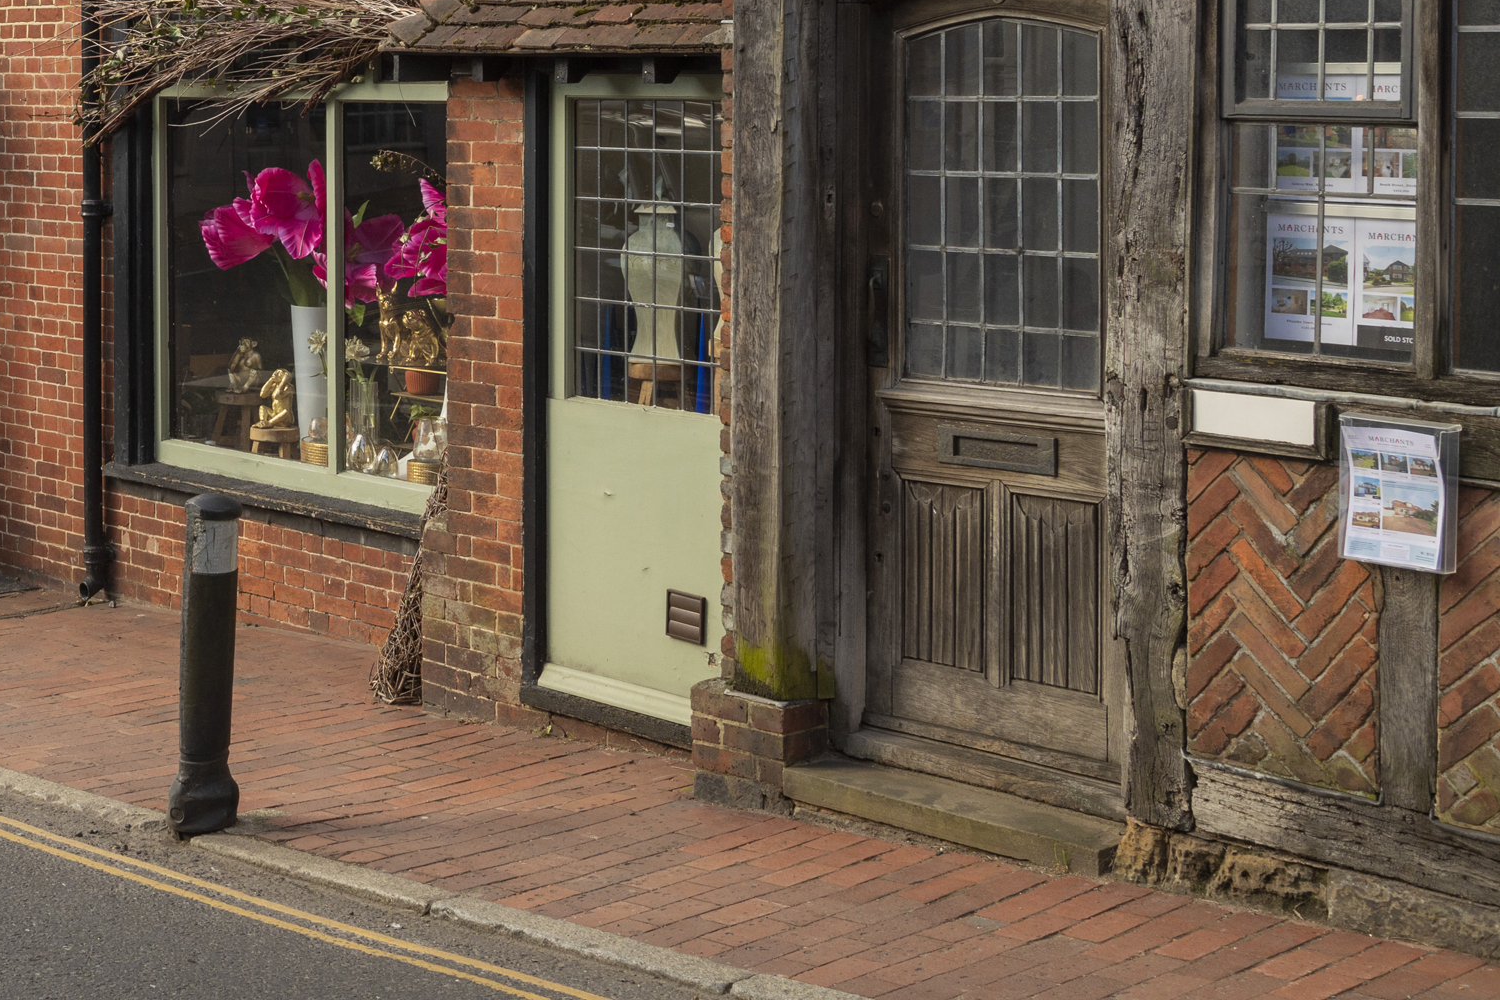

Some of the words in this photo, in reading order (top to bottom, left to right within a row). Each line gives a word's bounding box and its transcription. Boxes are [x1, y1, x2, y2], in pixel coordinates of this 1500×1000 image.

[1278, 82, 1347, 91] MARCHNTS
[1278, 223, 1344, 234] MARCHNTS
[1384, 335, 1401, 343] SOLD
[1368, 435, 1414, 446] MARCHANTS
